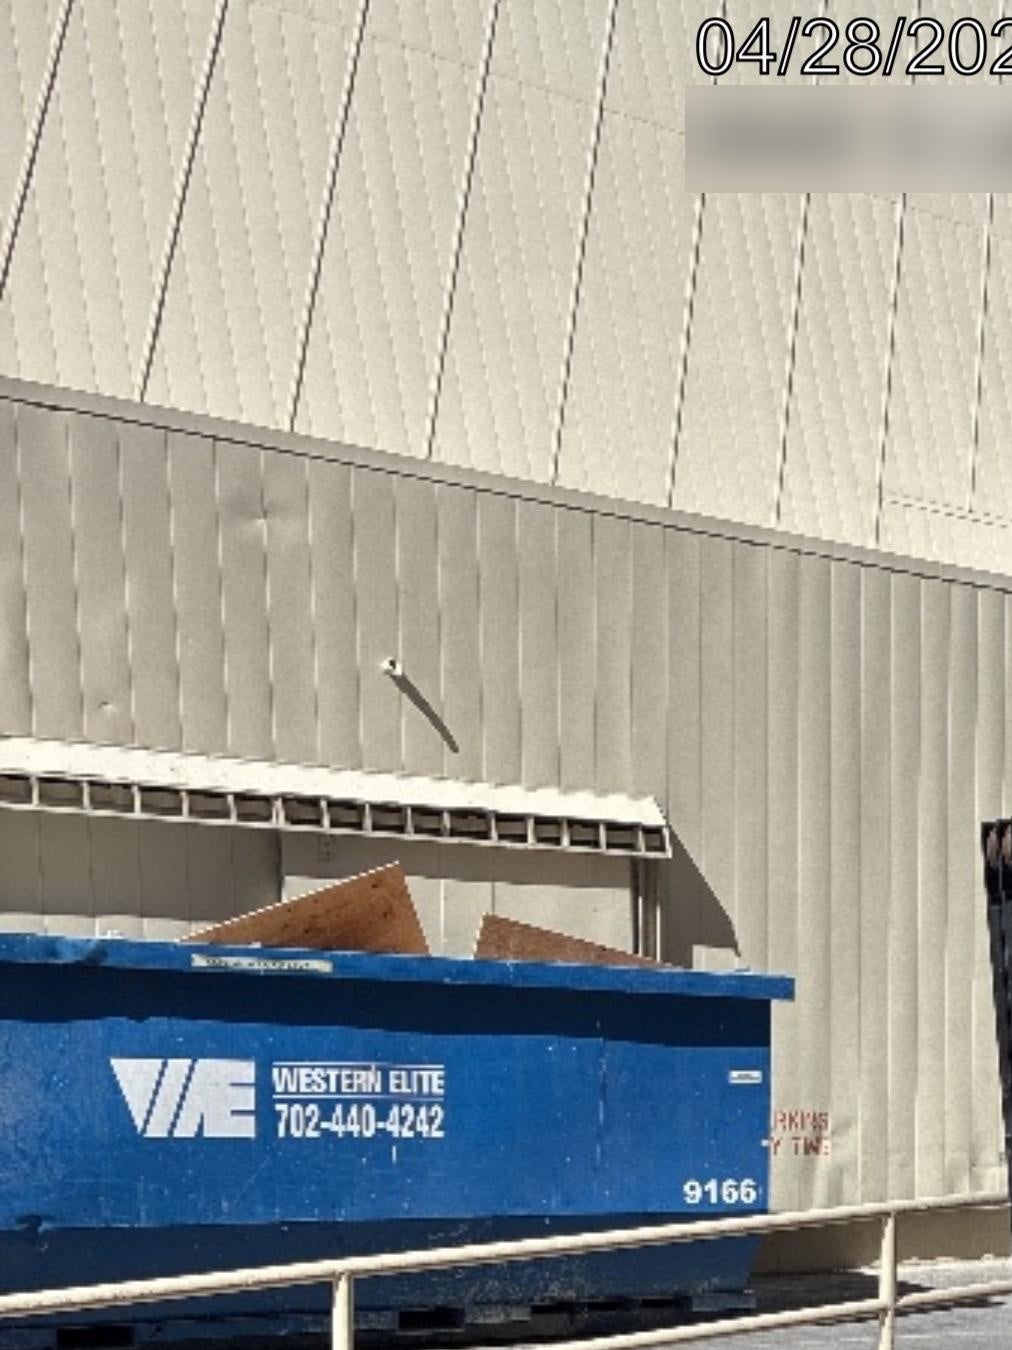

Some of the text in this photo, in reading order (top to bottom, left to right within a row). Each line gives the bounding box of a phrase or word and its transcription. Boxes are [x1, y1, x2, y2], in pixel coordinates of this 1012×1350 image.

[272, 1067, 445, 1096] WESTERN ELITE
[274, 1103, 445, 1138] 702-440-4242
[773, 1110, 829, 1131] RKING
[682, 1178, 758, 1204] 9166
